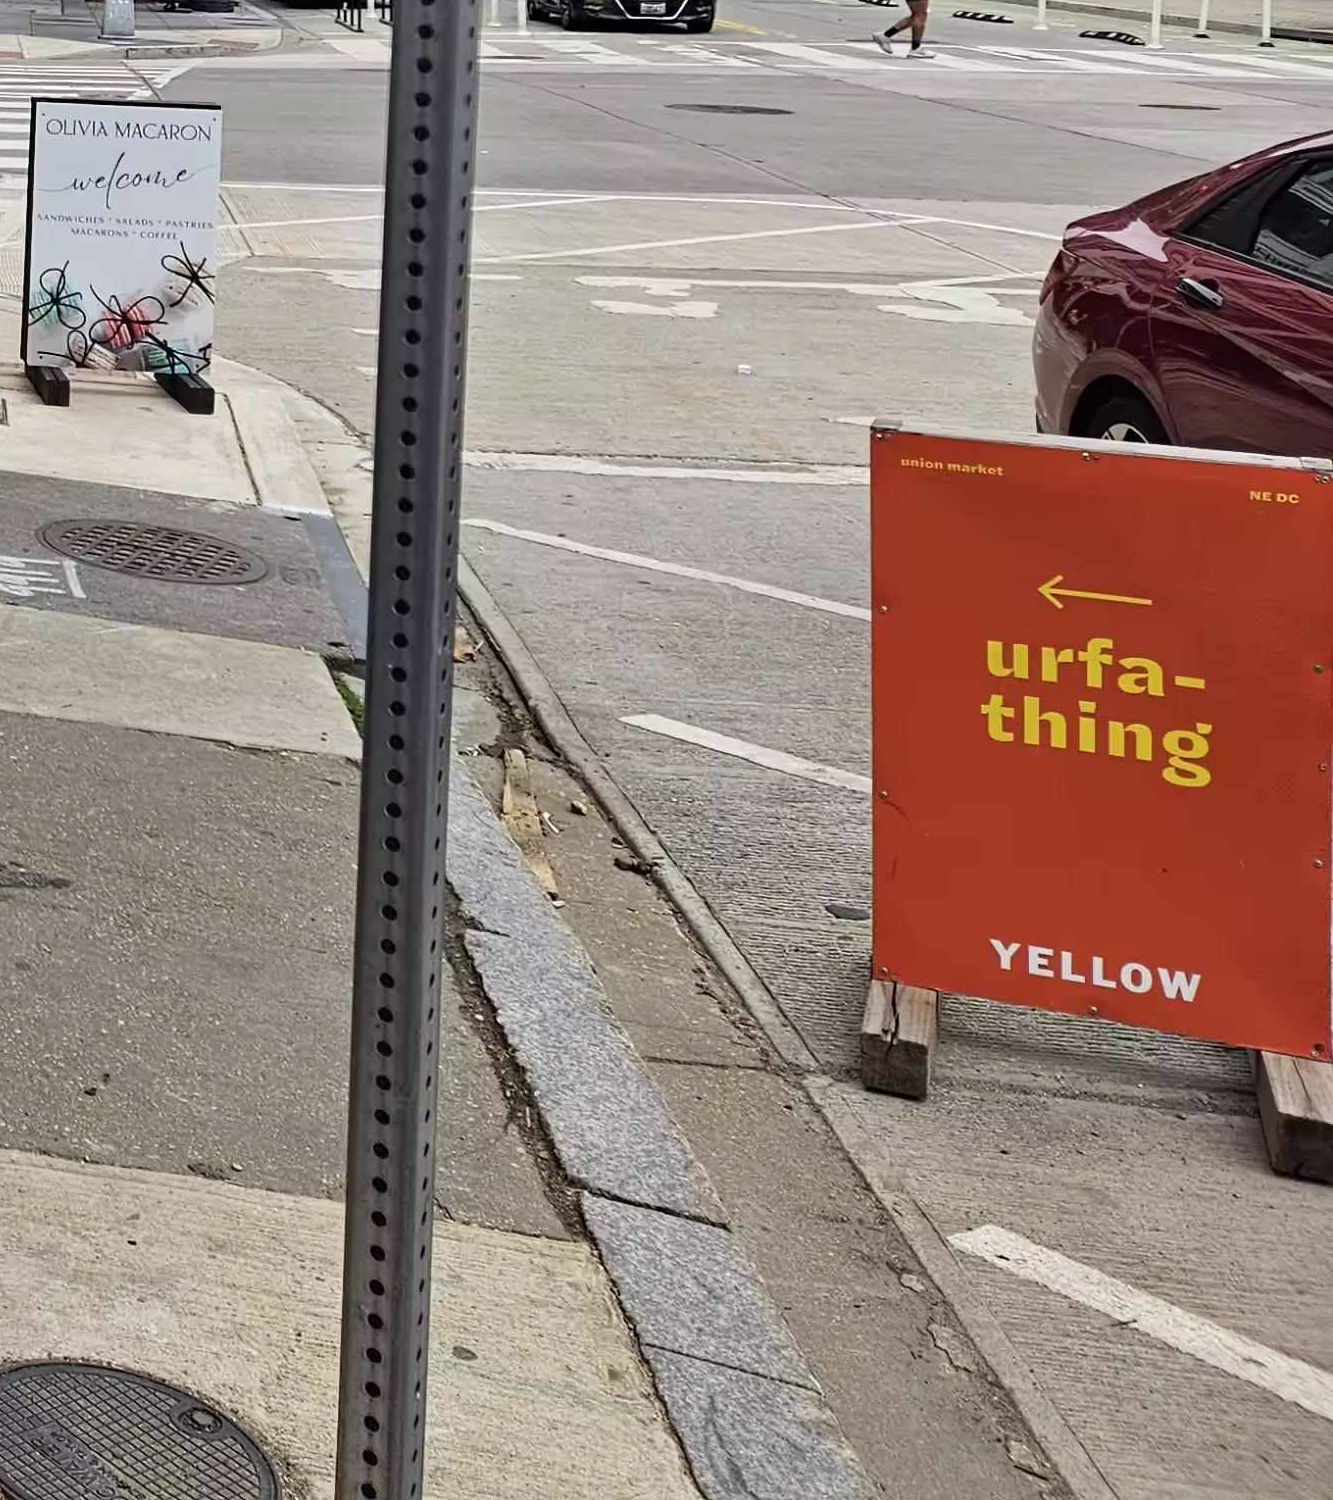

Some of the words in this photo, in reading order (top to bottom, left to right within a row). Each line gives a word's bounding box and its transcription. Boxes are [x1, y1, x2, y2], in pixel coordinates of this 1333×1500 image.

[46, 118, 108, 137] OLIVIA
[115, 121, 212, 142] MACARON
[39, 152, 216, 210] welcome
[37, 214, 104, 224] SANDWICHES
[116, 218, 154, 227] SALADS
[165, 220, 213, 229] PASTRIES
[70, 228, 129, 237] MACARONS
[140, 231, 179, 240] COFFEE
[900, 458, 943, 471] union
[947, 463, 1004, 477] market
[1249, 490, 1272, 502] NE
[1276, 493, 1299, 504] DC
[987, 637, 1206, 697] urfa-
[981, 694, 1213, 787] thing
[989, 937, 1201, 1003] YELLOW
